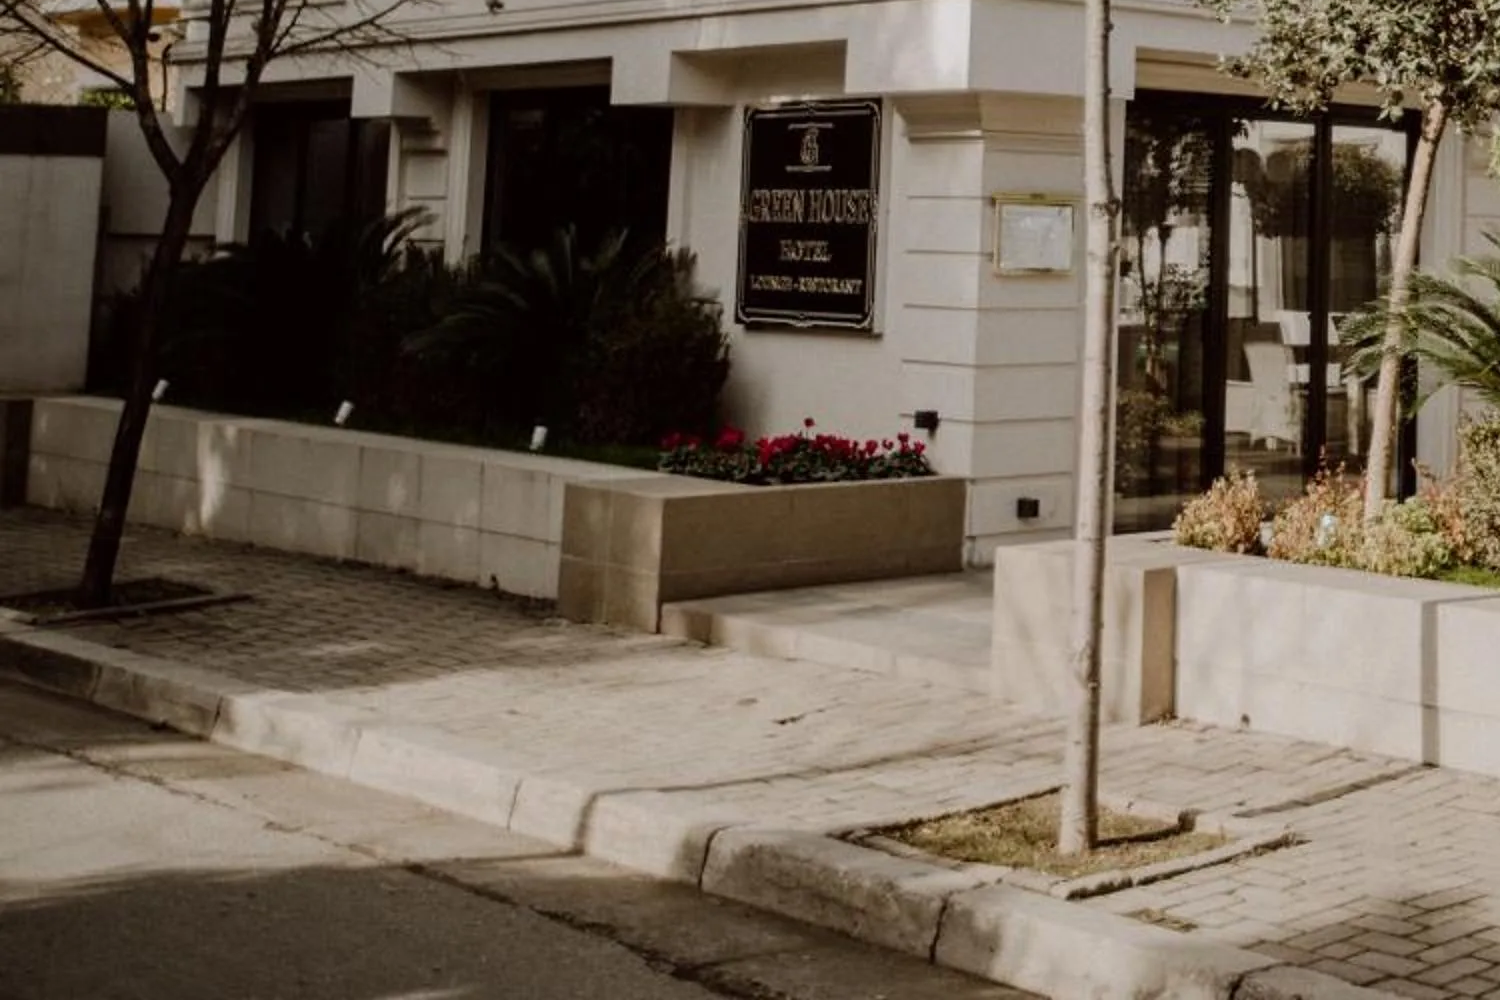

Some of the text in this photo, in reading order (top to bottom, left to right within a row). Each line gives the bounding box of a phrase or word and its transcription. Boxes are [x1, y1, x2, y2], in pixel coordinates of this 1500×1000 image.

[748, 189, 870, 224] GREEN HOUSE
[779, 239, 833, 262] HOTEL
